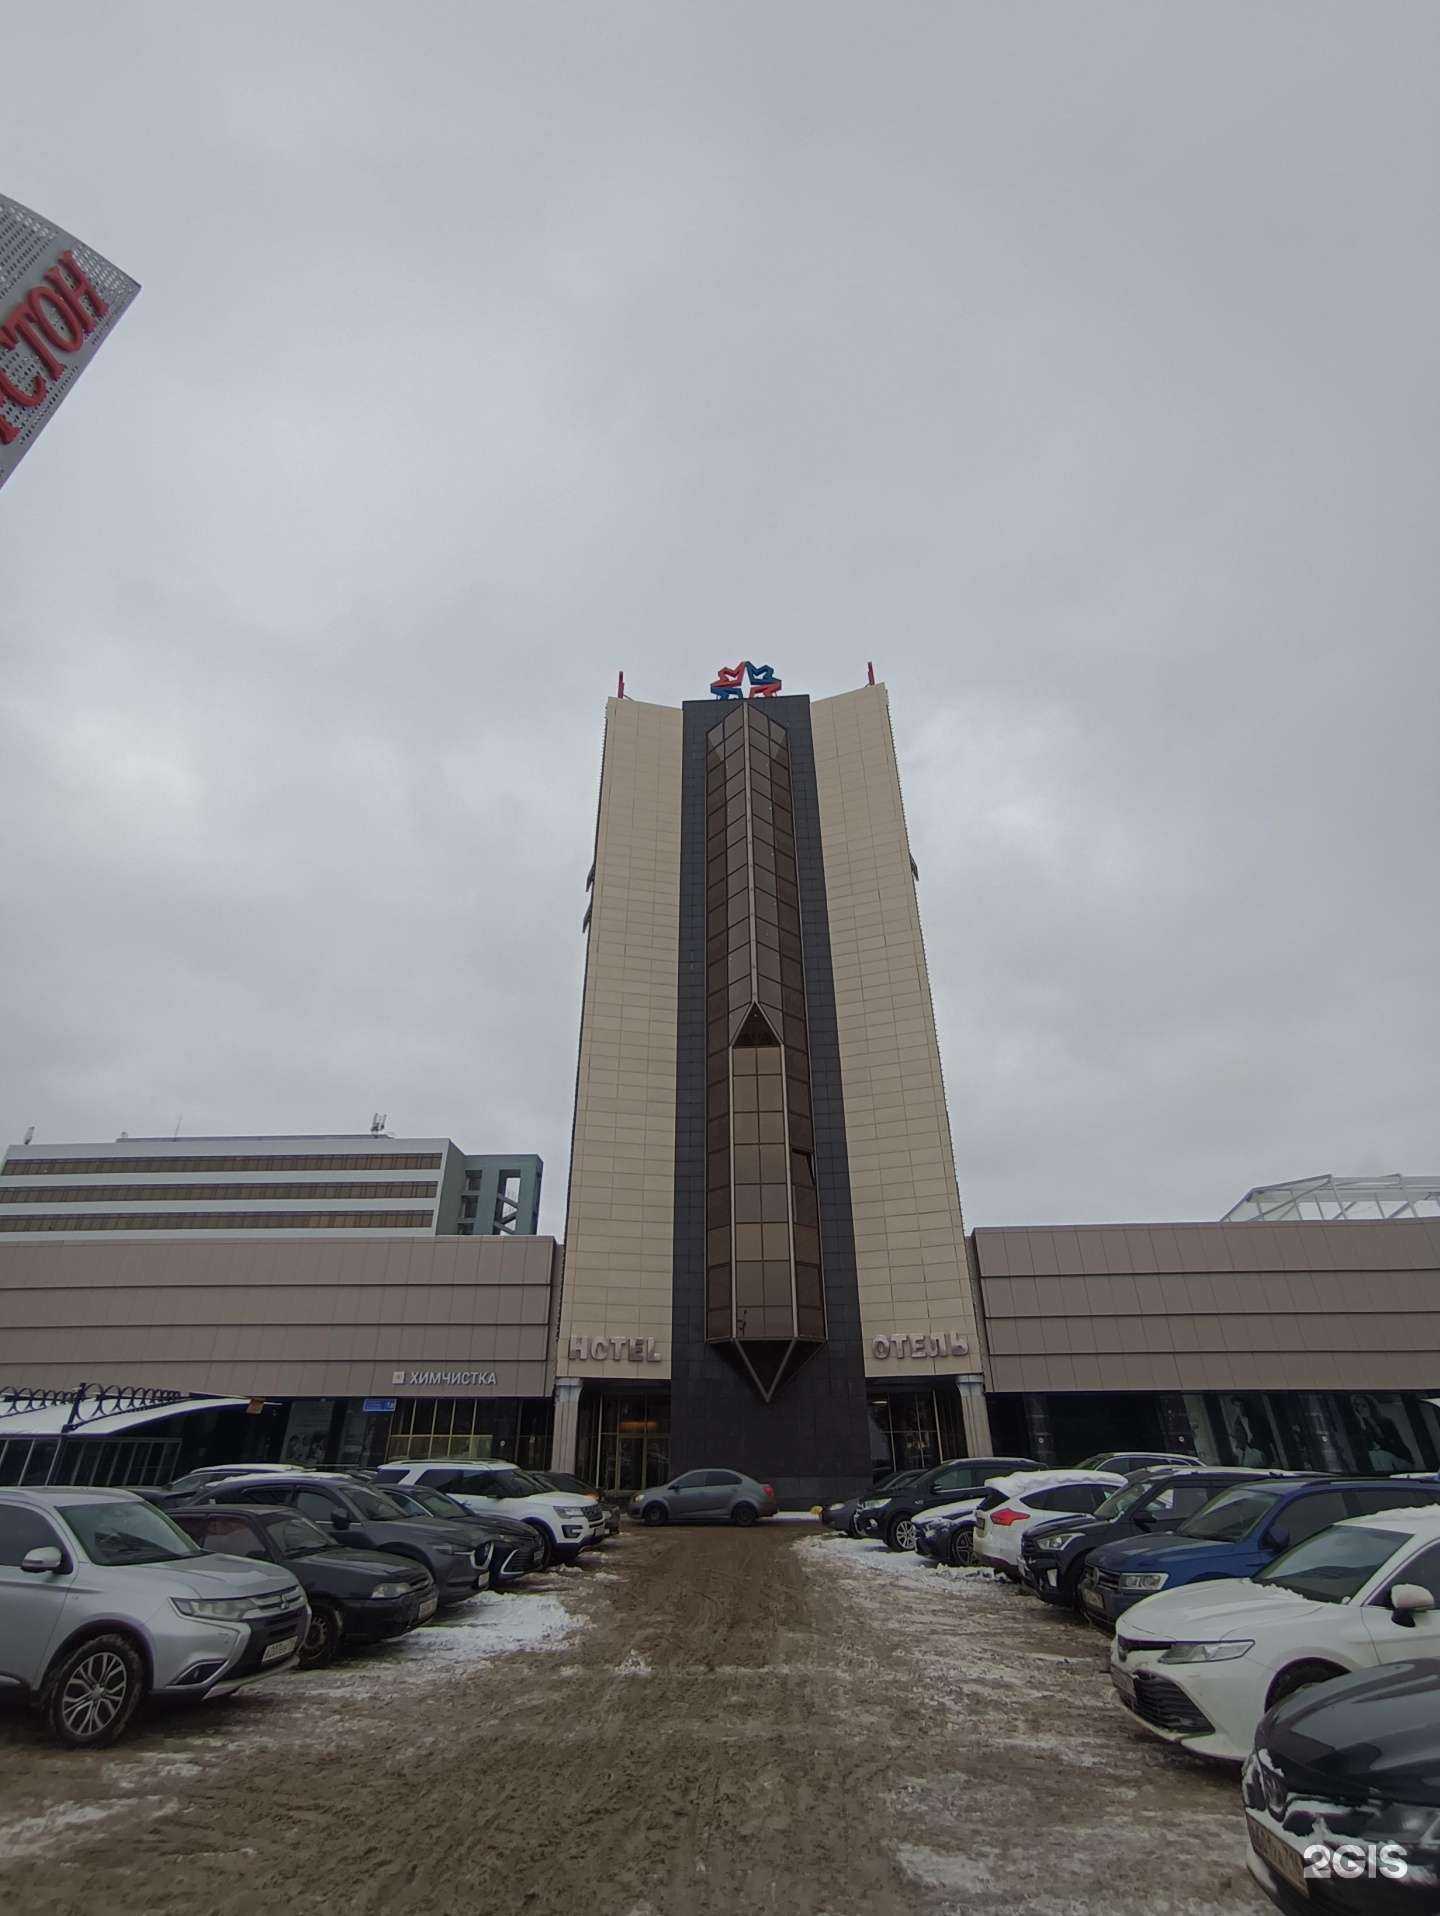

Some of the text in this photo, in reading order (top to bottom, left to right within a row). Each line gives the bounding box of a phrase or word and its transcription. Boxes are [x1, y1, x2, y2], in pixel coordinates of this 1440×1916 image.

[0, 249, 109, 444] СТОН
[567, 1335, 662, 1363] HOTEL
[872, 1332, 970, 1360] ОТЕЛЬ
[409, 1371, 497, 1386] ХИМЧИСТКА
